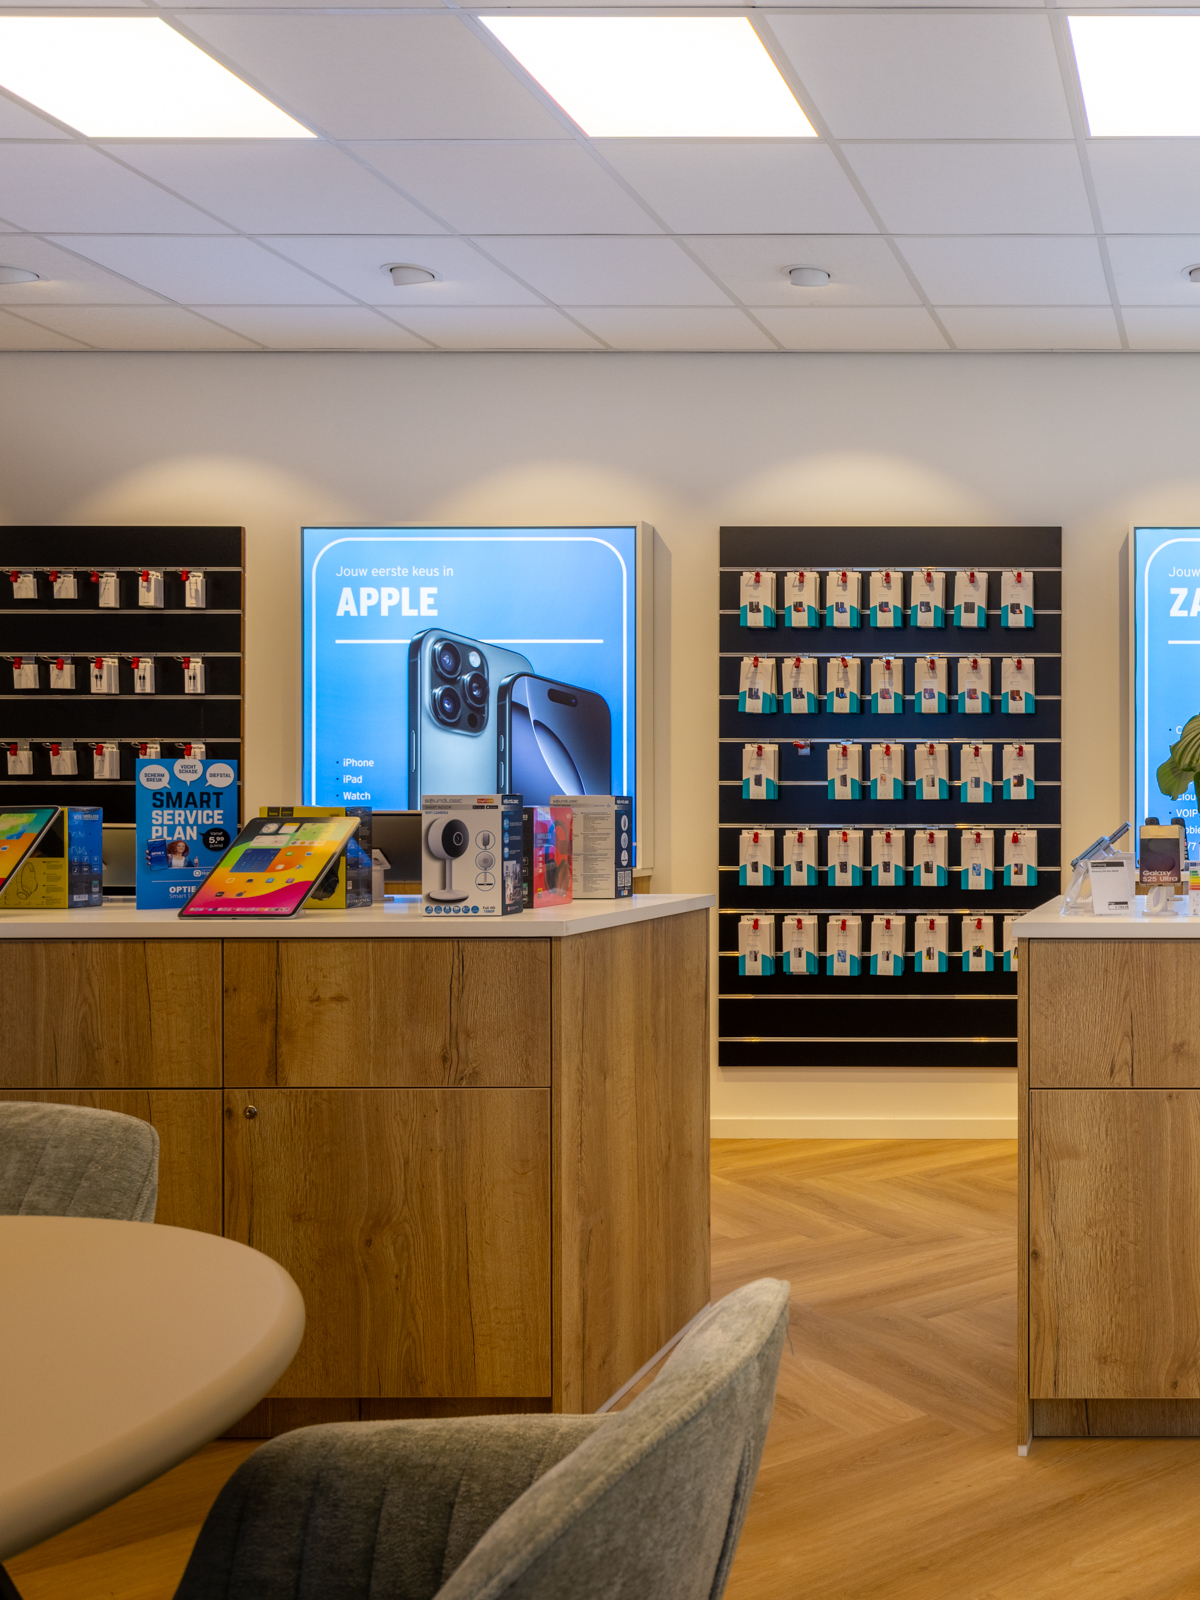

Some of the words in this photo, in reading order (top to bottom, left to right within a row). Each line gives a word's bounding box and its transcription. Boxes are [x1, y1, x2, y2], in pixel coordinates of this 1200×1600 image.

[335, 566, 368, 577] Jouw
[371, 566, 408, 577] eerste
[412, 566, 440, 577] keus
[443, 566, 453, 577] in
[1168, 566, 1200, 577] Jouw
[336, 587, 438, 617] APPLE
[343, 758, 375, 767] iPhone
[343, 775, 363, 784] iPad
[152, 791, 224, 809] SMART
[343, 791, 371, 801] Watch
[151, 809, 224, 825] SERVICE
[1175, 808, 1198, 818] VOIP
[151, 826, 197, 841] PLAN
